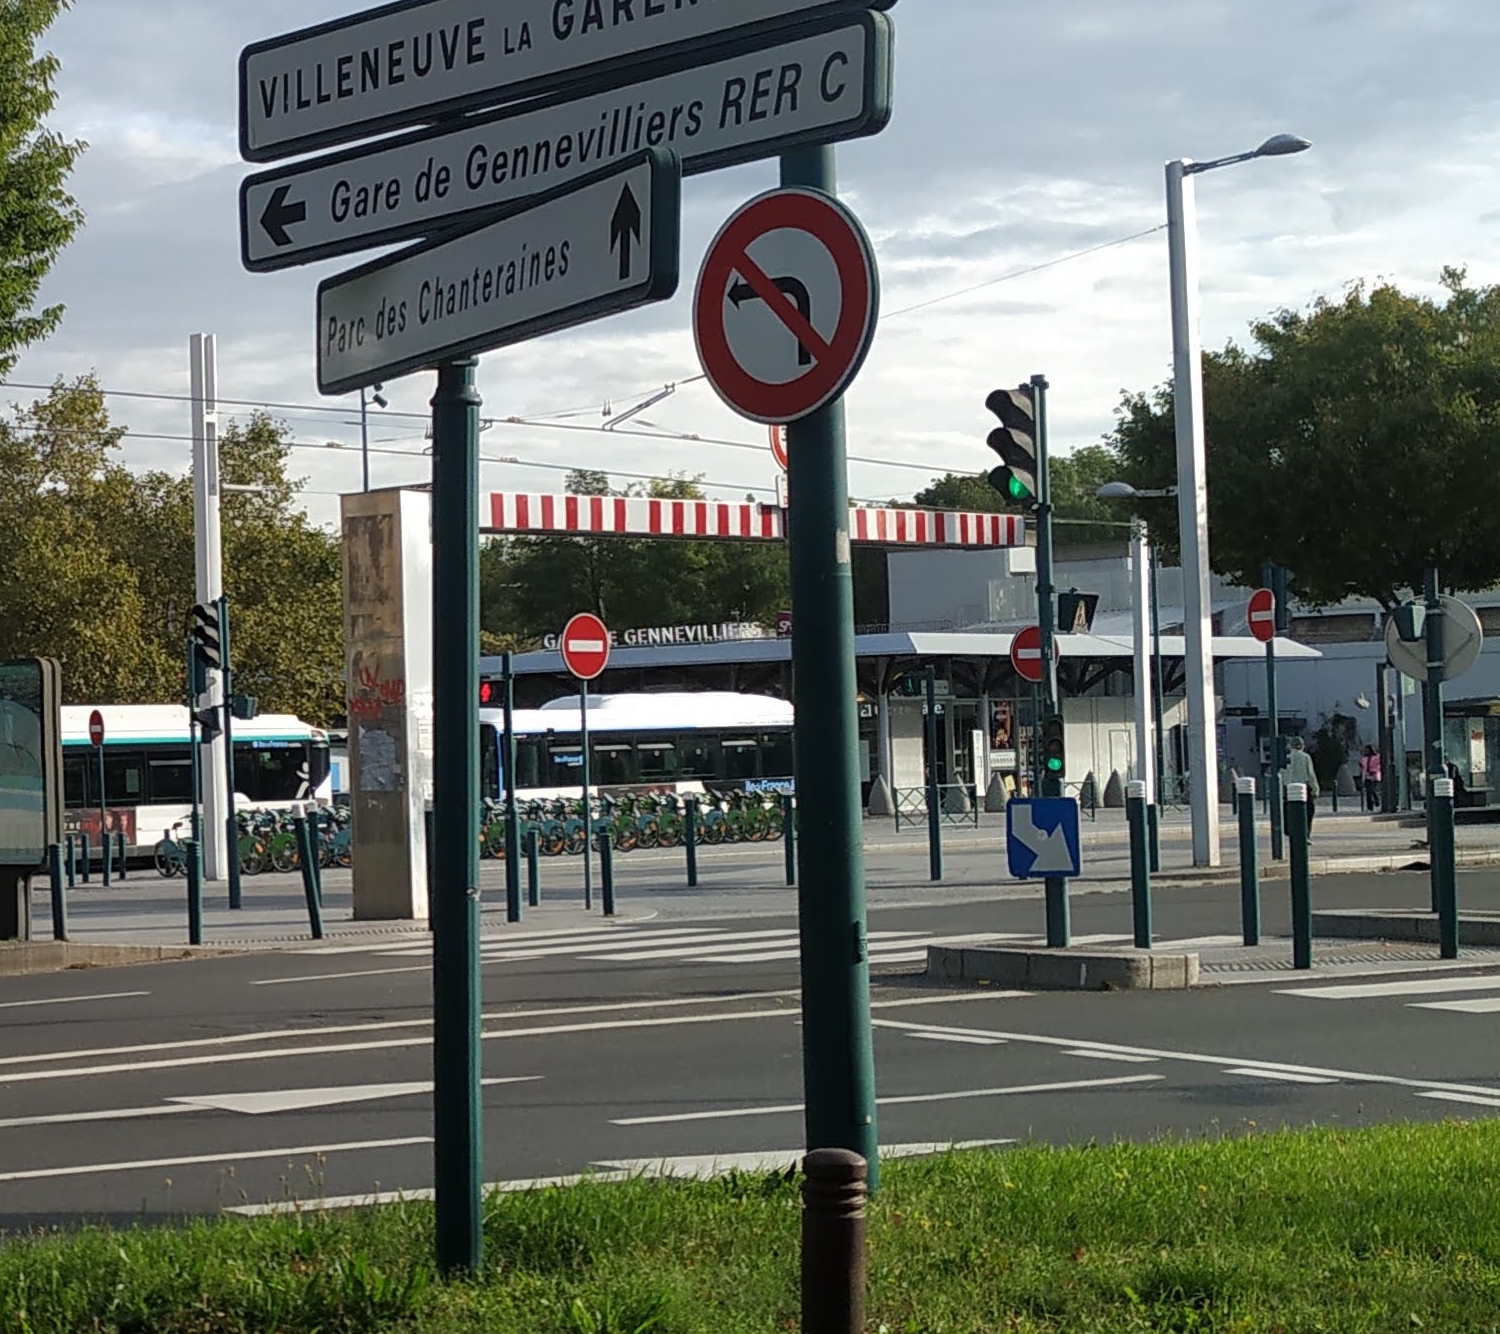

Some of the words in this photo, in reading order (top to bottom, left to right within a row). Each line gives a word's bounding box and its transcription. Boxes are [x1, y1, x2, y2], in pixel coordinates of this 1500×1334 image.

[259, 17, 485, 118] VILLENEUVE
[503, 22, 532, 55] LA
[331, 179, 400, 223] Gare
[414, 156, 451, 203] de
[465, 99, 703, 190] Gennevilliers
[718, 62, 802, 129] RER
[820, 50, 849, 103] C
[327, 315, 365, 357] Parc
[375, 296, 407, 341] des
[418, 239, 571, 326] Chanteraines
[623, 621, 762, 645] GENNEVILLIERS
